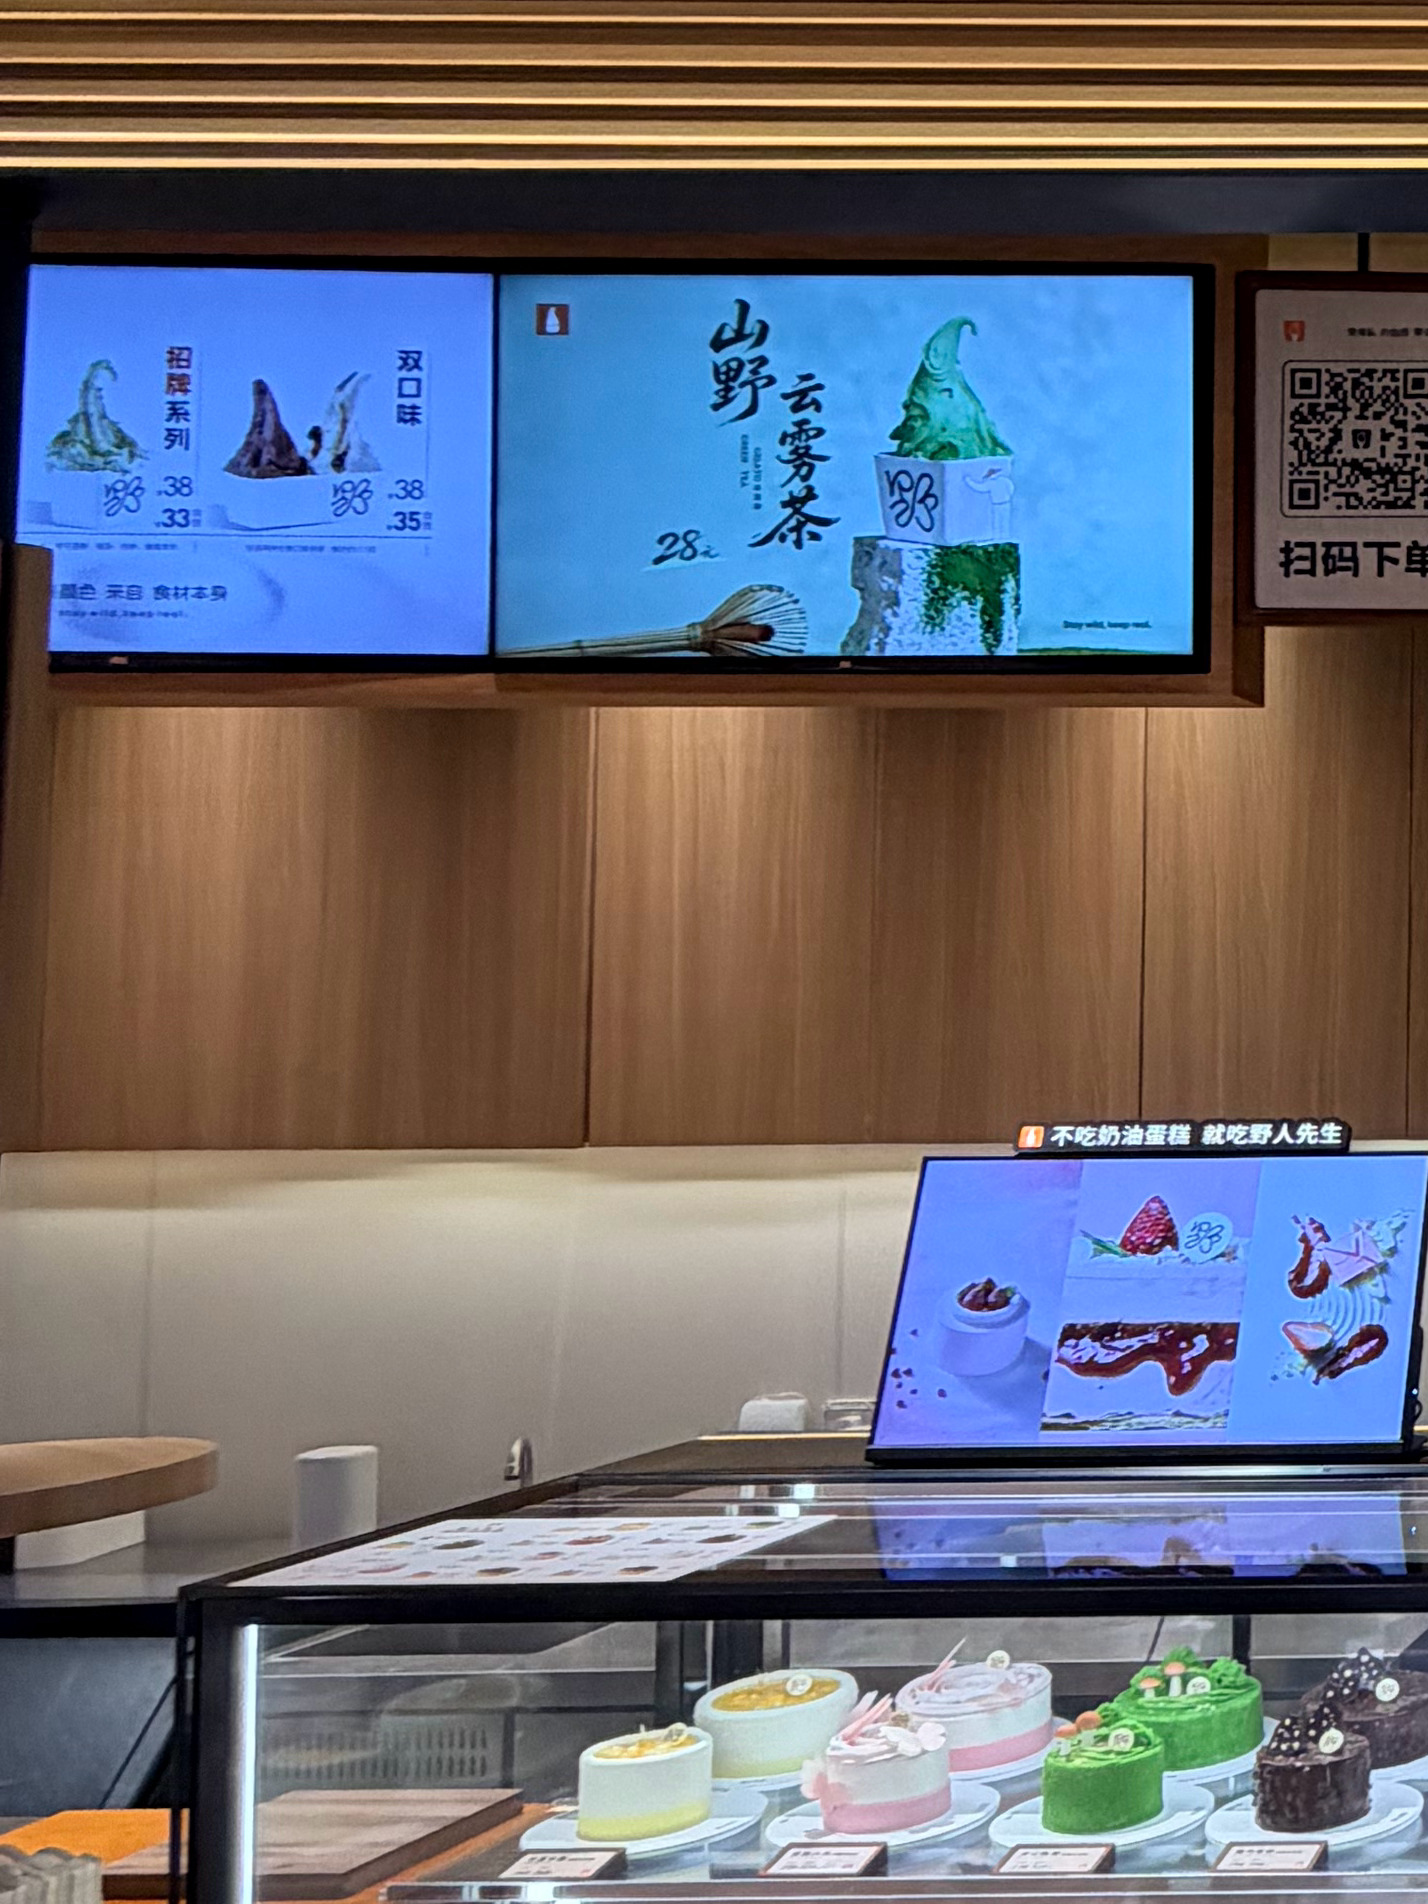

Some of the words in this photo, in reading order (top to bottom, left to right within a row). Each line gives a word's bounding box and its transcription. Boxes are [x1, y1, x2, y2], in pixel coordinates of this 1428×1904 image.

[164, 346, 193, 451] 招牌系列
[395, 350, 424, 427] 双口味
[709, 299, 778, 426] 山野
[748, 373, 841, 550] 云雾茶
[1050, 1125, 1191, 1147] 不吃奶油蛋糕
[1201, 1122, 1343, 1145] 就吃野人先生
